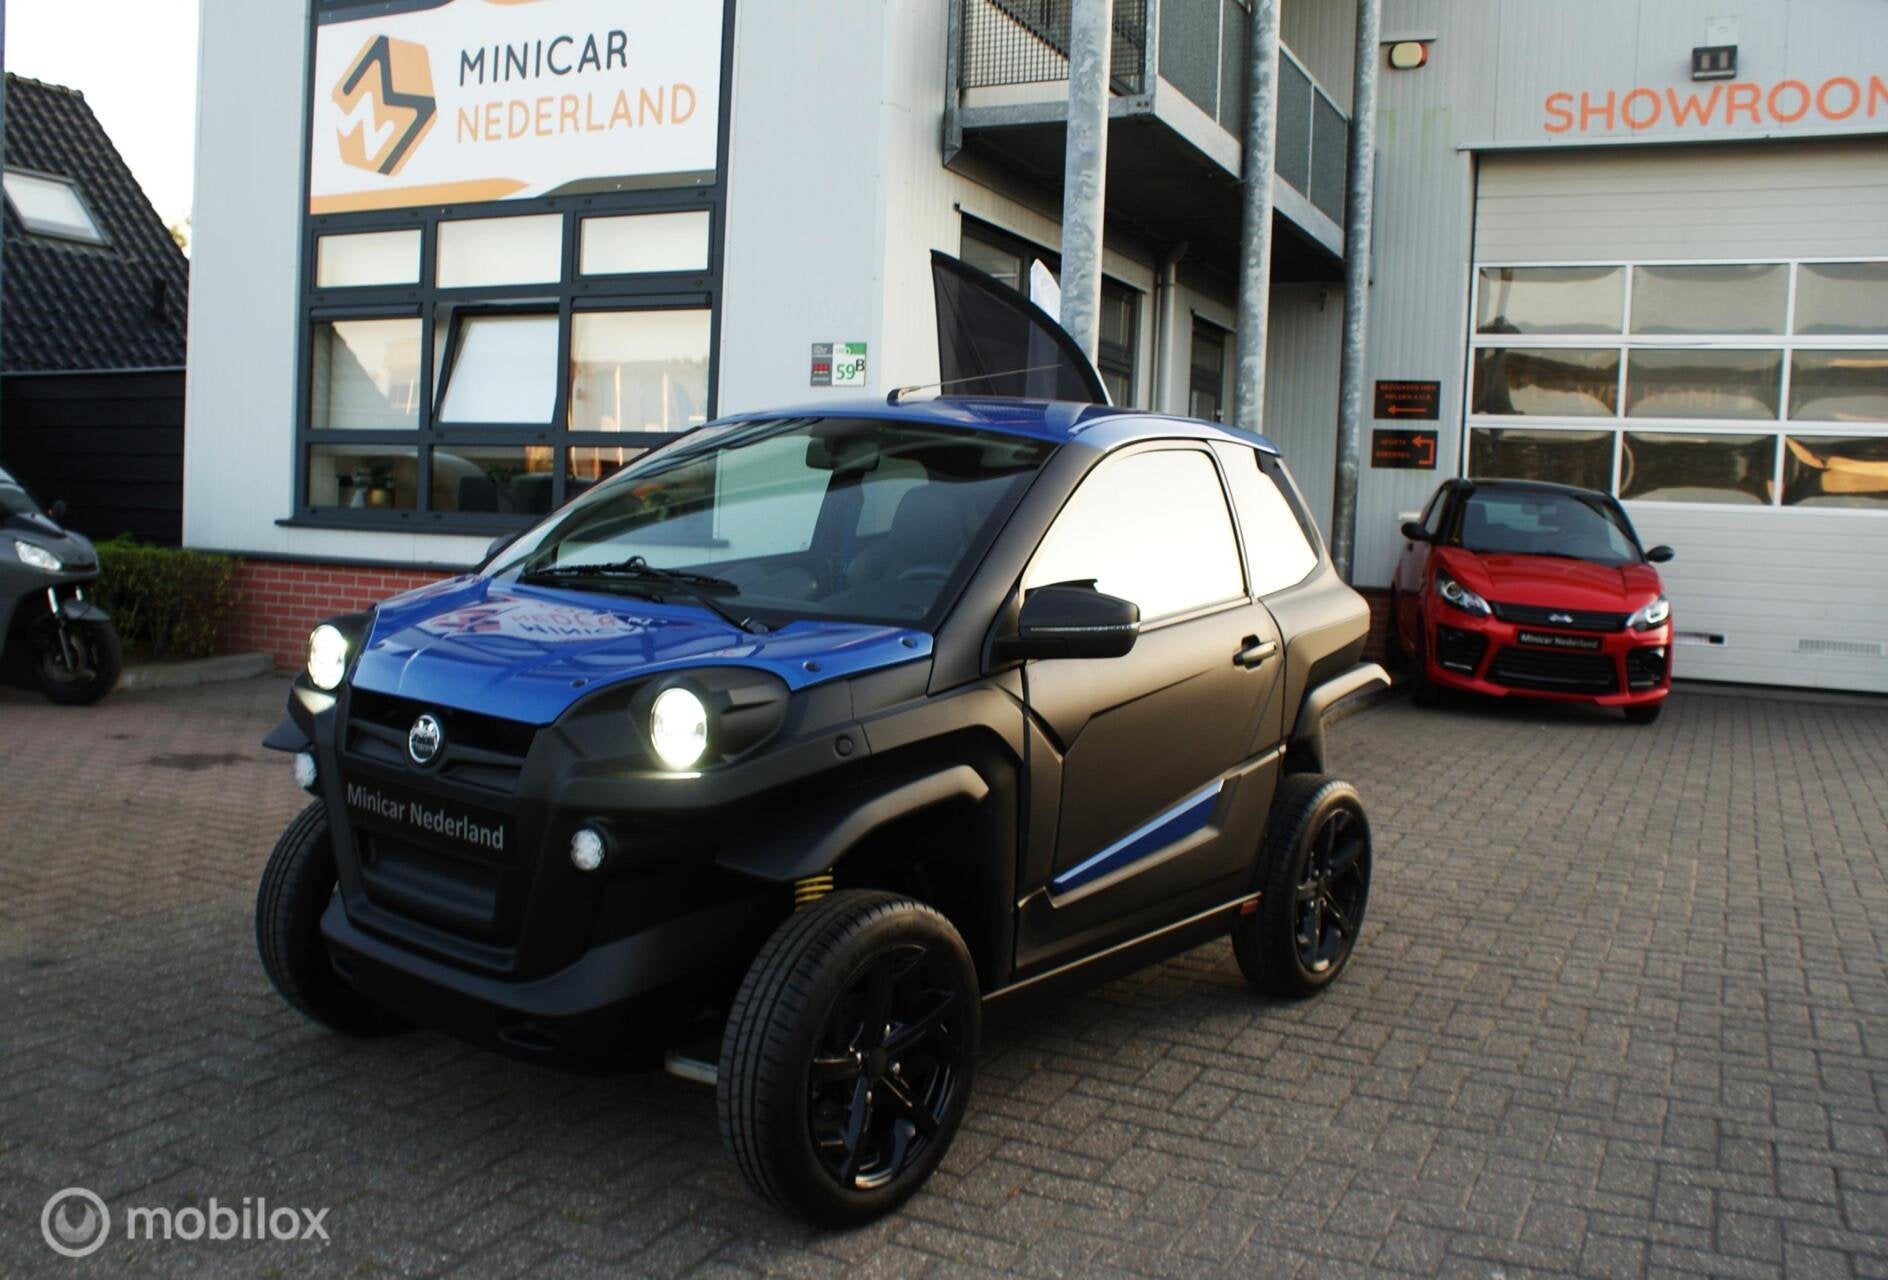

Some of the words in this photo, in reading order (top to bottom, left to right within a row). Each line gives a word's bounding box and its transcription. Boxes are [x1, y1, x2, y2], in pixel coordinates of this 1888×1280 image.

[459, 30, 628, 86] MINICAR
[456, 83, 697, 144] NEDERLAND
[1520, 632, 1552, 645] Minicar
[1555, 636, 1599, 649] Nederland
[347, 783, 406, 820] Minicar
[410, 803, 504, 850] Nederland
